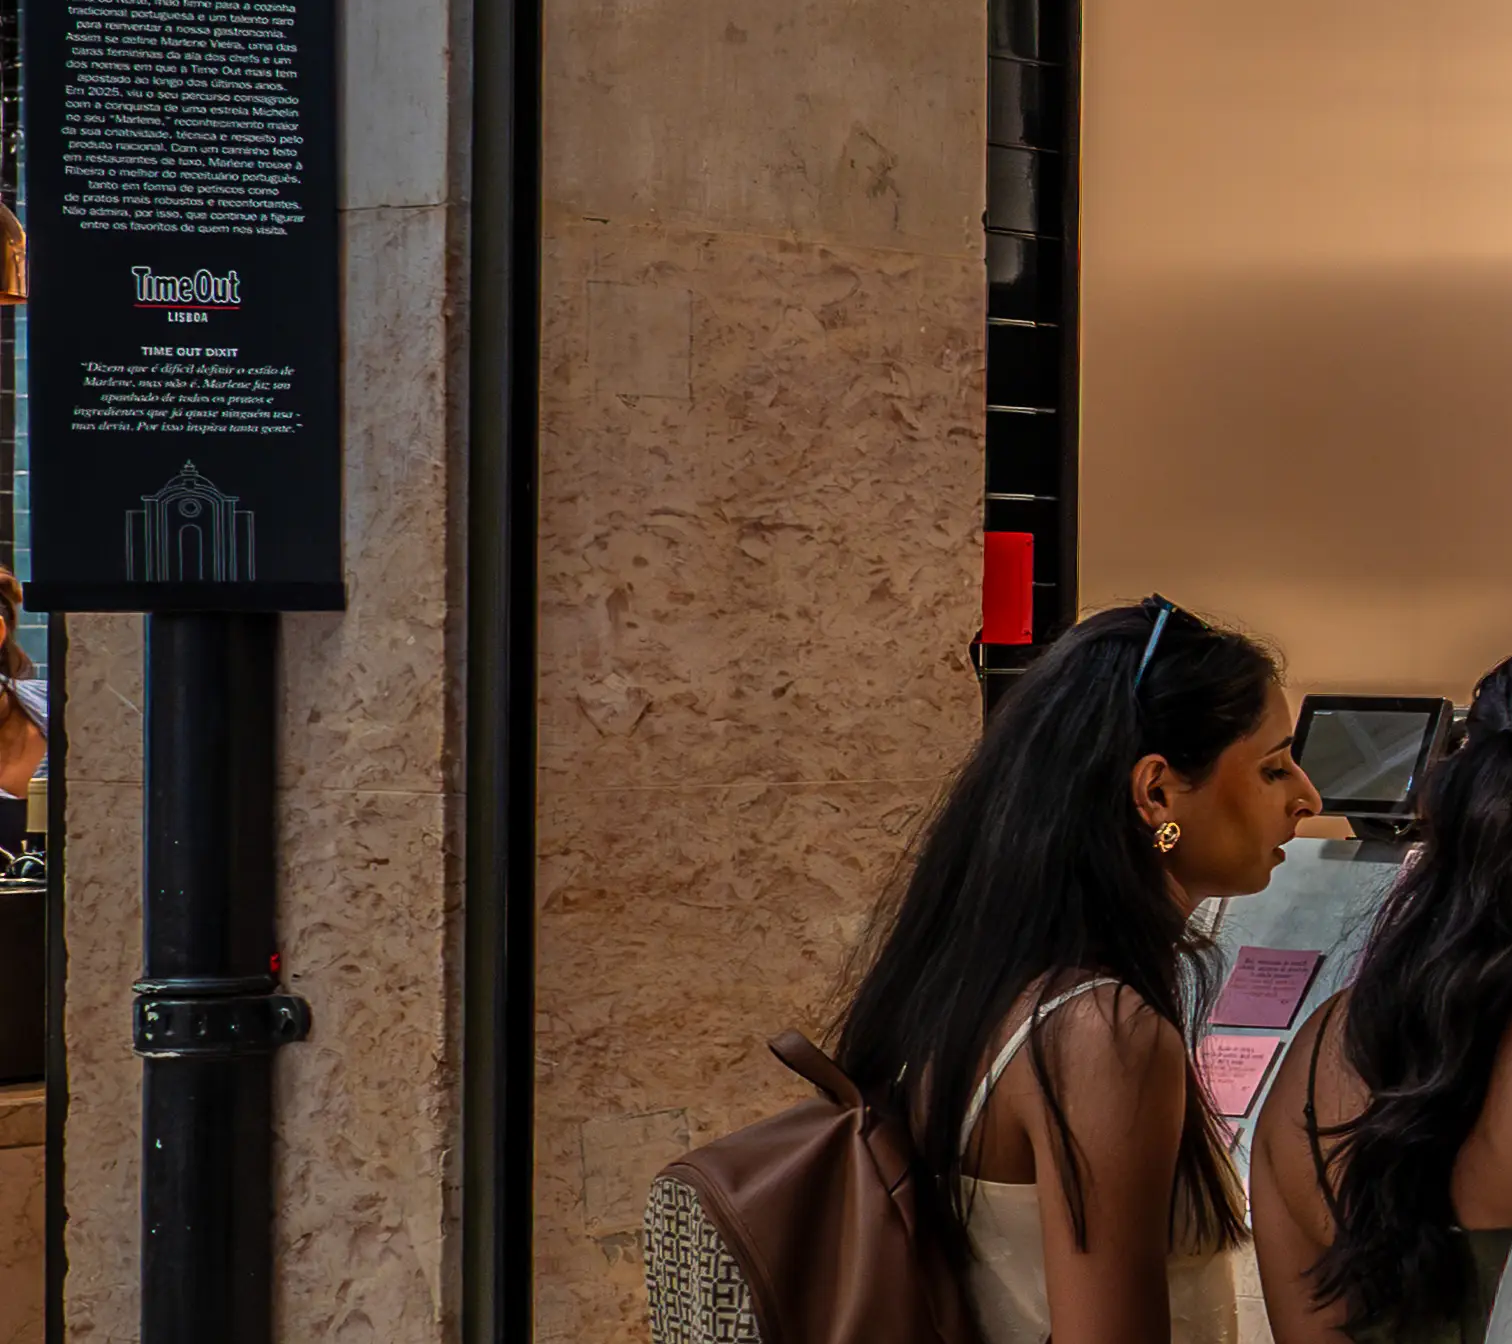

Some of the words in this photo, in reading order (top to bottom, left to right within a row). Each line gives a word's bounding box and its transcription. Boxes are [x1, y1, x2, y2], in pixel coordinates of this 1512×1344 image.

[167, 311, 208, 323] LISBOA
[141, 346, 173, 356] TIME
[176, 347, 203, 356] OUT
[205, 347, 239, 357] DIXIT
